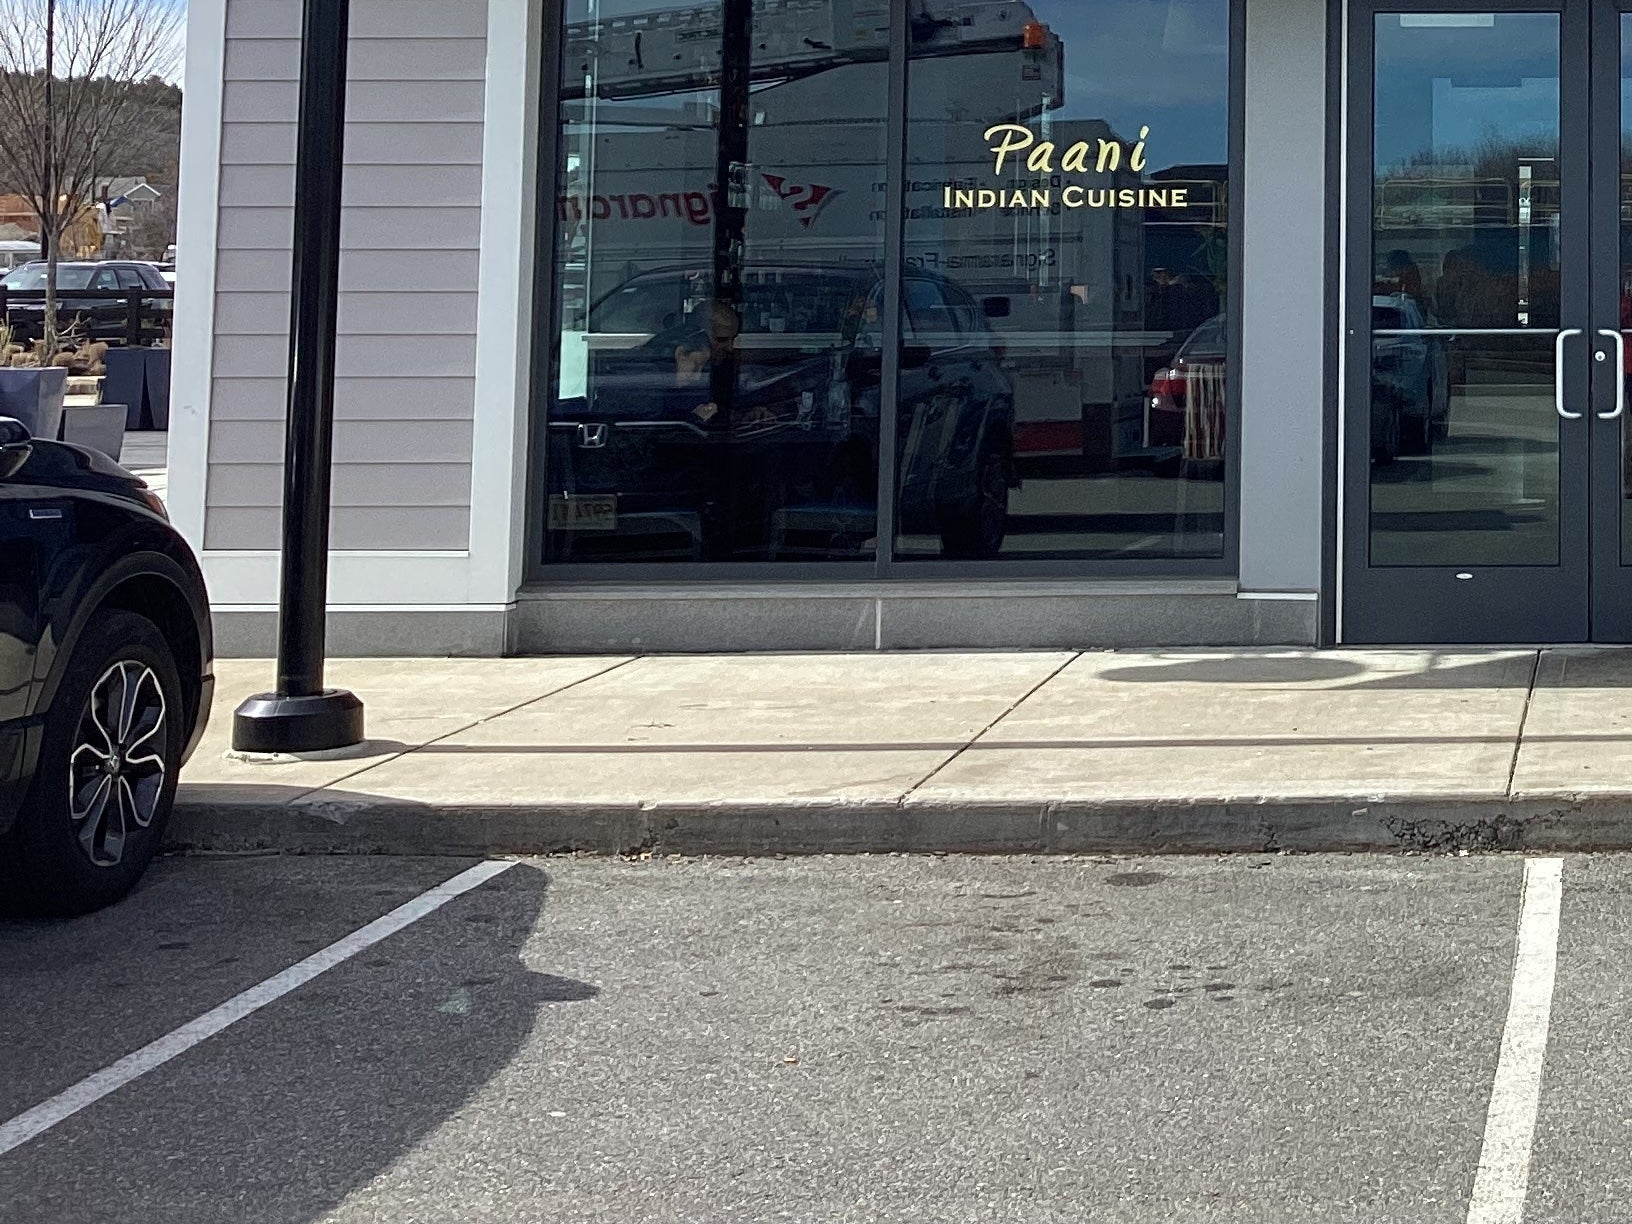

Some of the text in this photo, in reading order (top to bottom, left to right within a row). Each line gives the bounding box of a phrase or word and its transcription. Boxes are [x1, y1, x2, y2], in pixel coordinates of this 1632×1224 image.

[983, 124, 1149, 175] Paani
[943, 185, 1188, 208] INDIAN CUISINE
